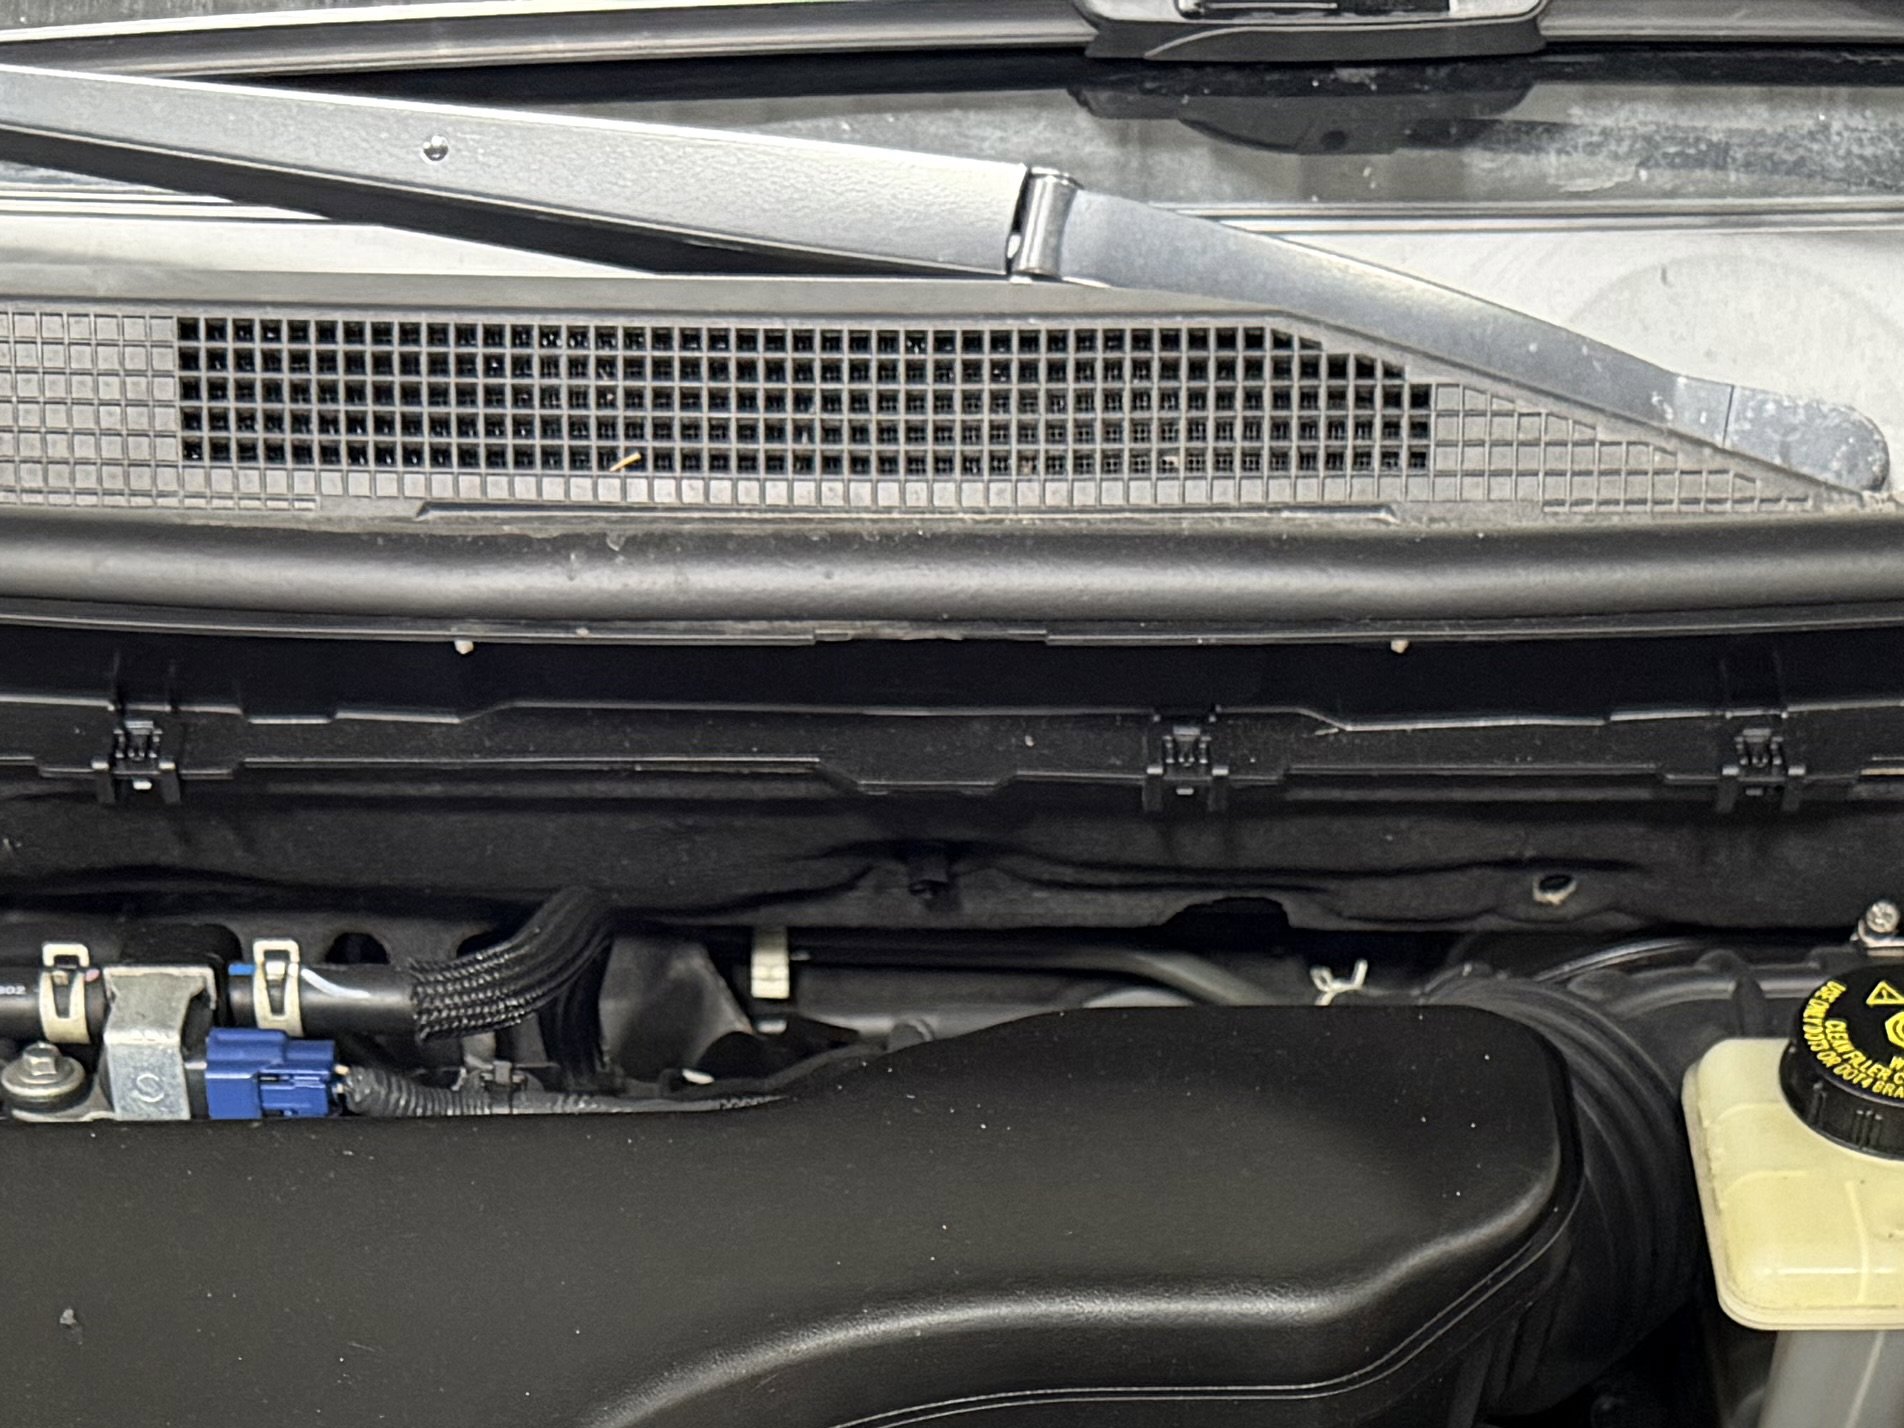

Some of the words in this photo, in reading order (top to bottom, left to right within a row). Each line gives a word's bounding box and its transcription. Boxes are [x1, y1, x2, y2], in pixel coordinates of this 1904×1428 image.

[1816, 1050, 1842, 1067] OR
[1833, 1064, 1873, 1088] DOT4
[1825, 1018, 1854, 1053] CLEAN
[1843, 1049, 1892, 1079] FILLER
